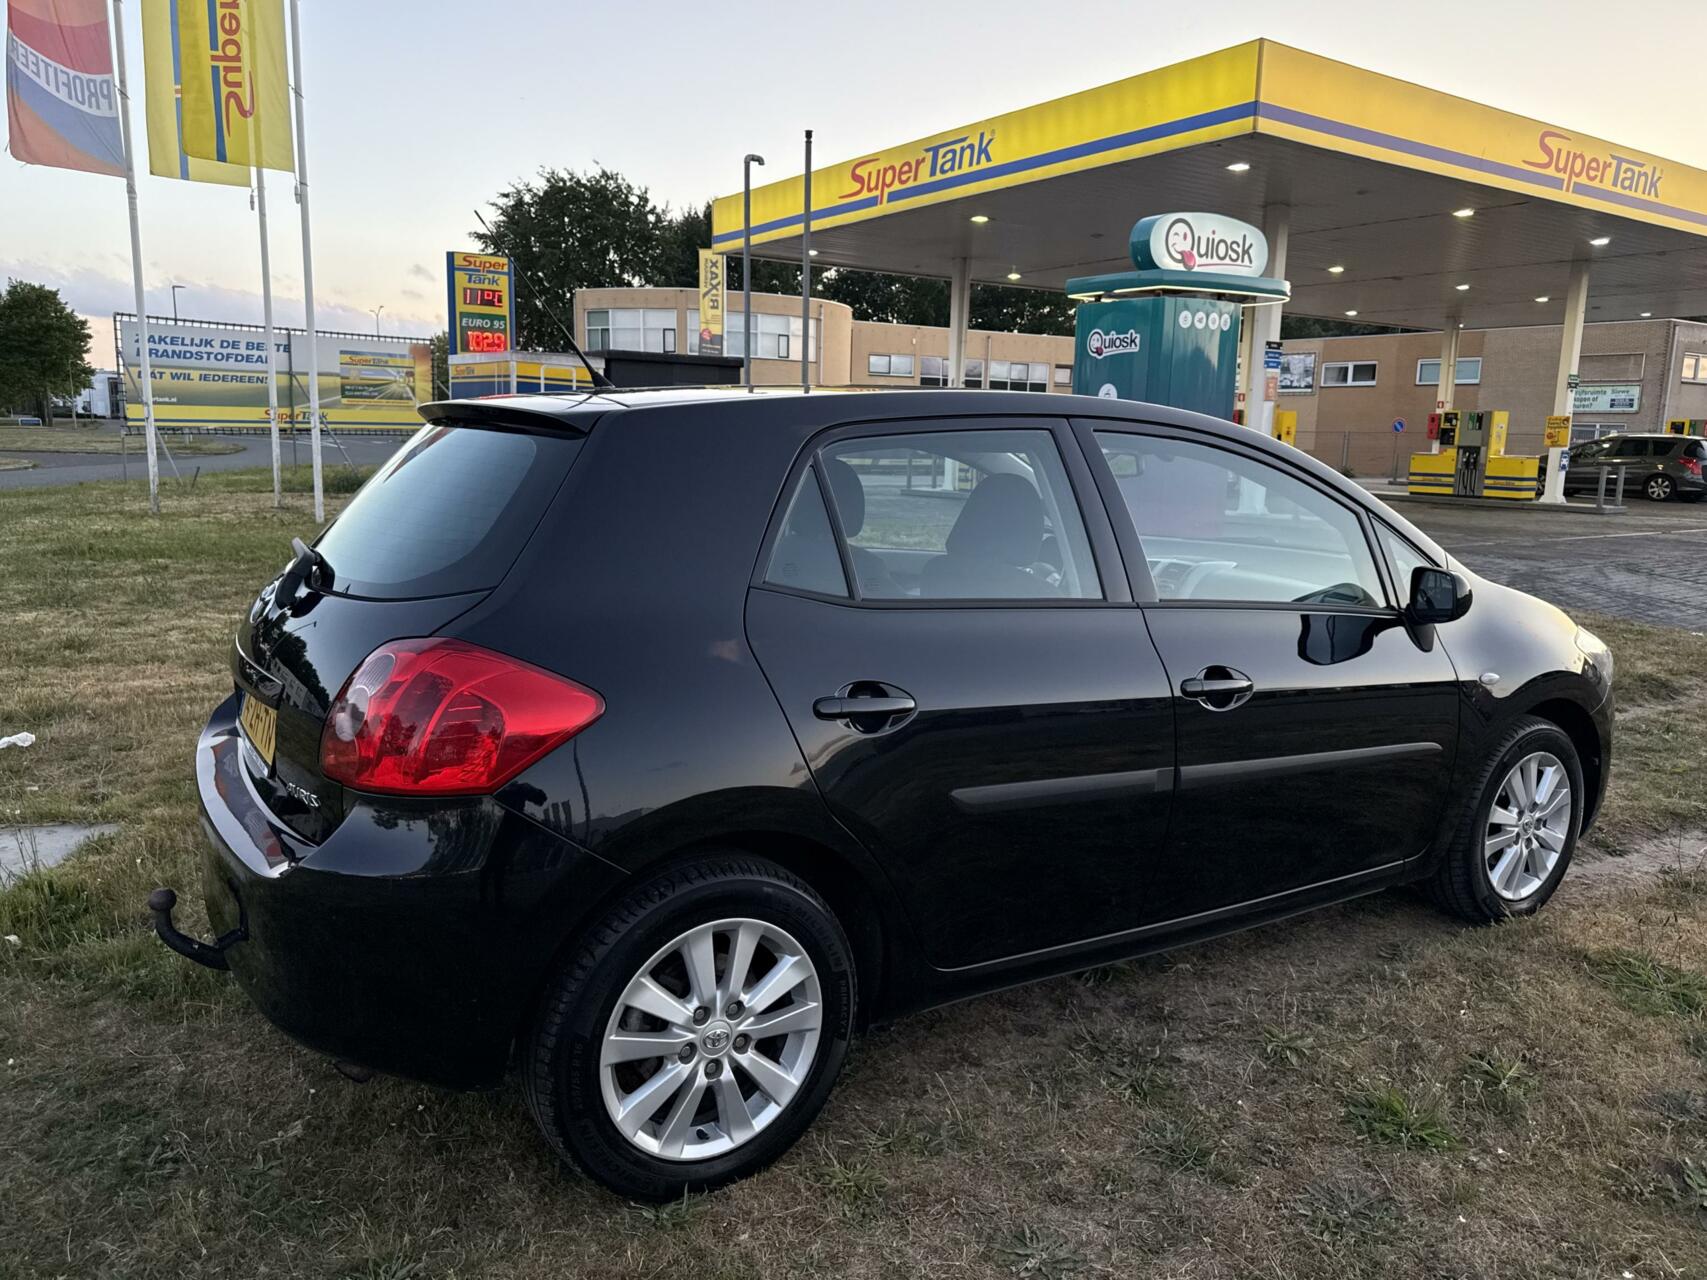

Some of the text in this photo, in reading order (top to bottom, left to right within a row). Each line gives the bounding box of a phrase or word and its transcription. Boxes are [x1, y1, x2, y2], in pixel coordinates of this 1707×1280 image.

[838, 131, 994, 205] SuperTank
[1521, 130, 1662, 198] SuperTank
[1165, 218, 1253, 270] Quiosk
[456, 255, 507, 273] Super
[464, 272, 500, 286] Tank
[461, 317, 505, 329] EURO 95
[220, 340, 241, 350] DE
[245, 341, 290, 353] BETE
[1089, 330, 1138, 356] Quiosk
[170, 372, 195, 382] WIL
[198, 373, 268, 385] IEDEREEN!
